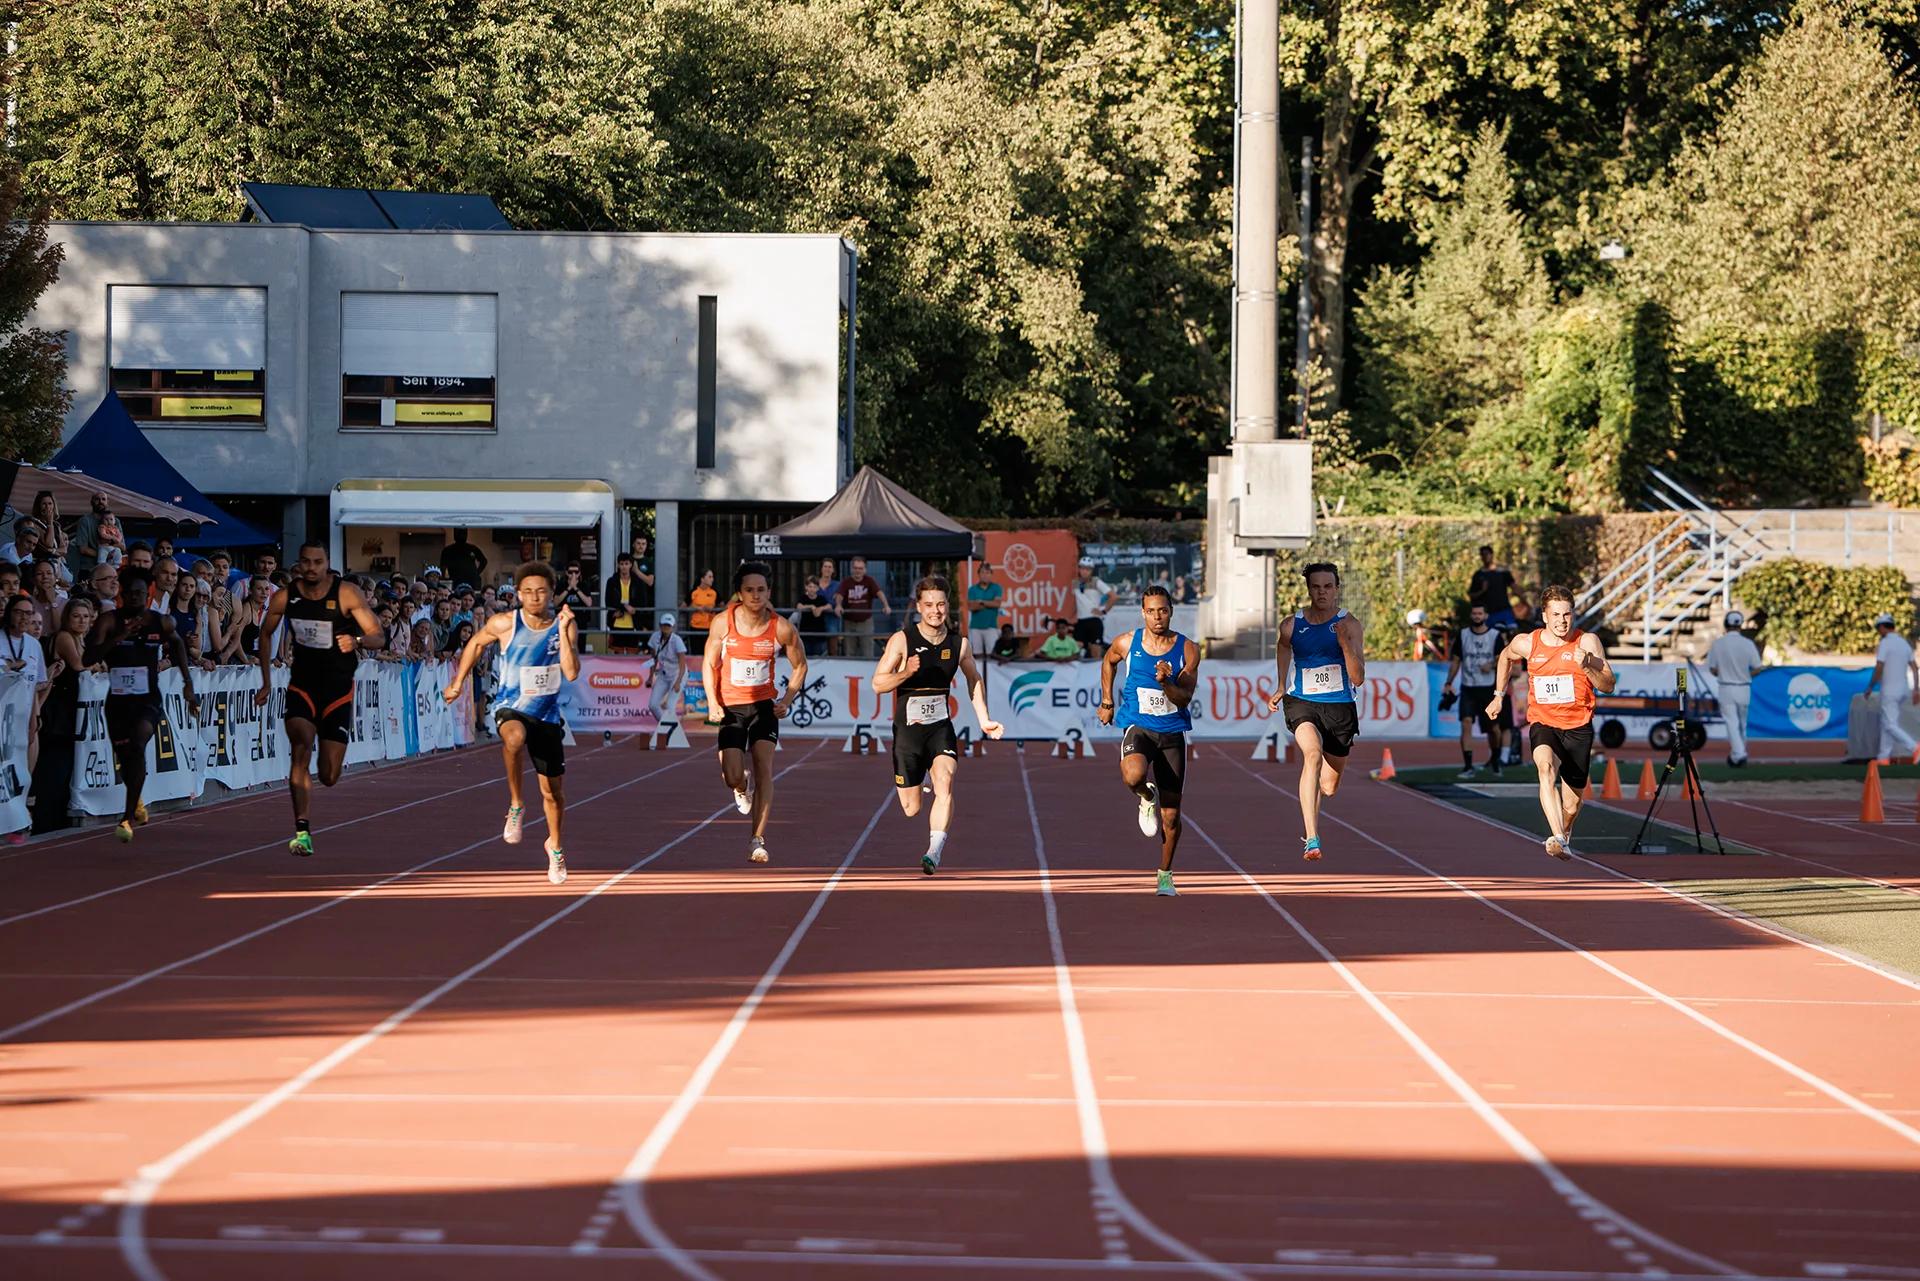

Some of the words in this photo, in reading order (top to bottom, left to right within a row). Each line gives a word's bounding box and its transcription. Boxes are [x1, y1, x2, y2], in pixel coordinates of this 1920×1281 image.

[402, 376, 428, 386] Seit
[433, 376, 465, 387] 1894.
[753, 534, 781, 547] LCB
[753, 546, 783, 555] BASEL
[1000, 580, 1068, 612] uality
[1012, 607, 1055, 635] lub
[746, 667, 755, 676] 91
[121, 675, 136, 684] 775
[535, 674, 550, 684] 257
[592, 676, 630, 686] familia
[1315, 672, 1330, 683] 208
[1545, 683, 1559, 693] 311
[1149, 697, 1165, 706] 539
[1207, 676, 1273, 721] UBS
[577, 708, 601, 717] JETZT
[603, 708, 620, 717] ALS
[921, 704, 936, 714] 579
[660, 721, 678, 746] 7
[855, 723, 873, 750] 5
